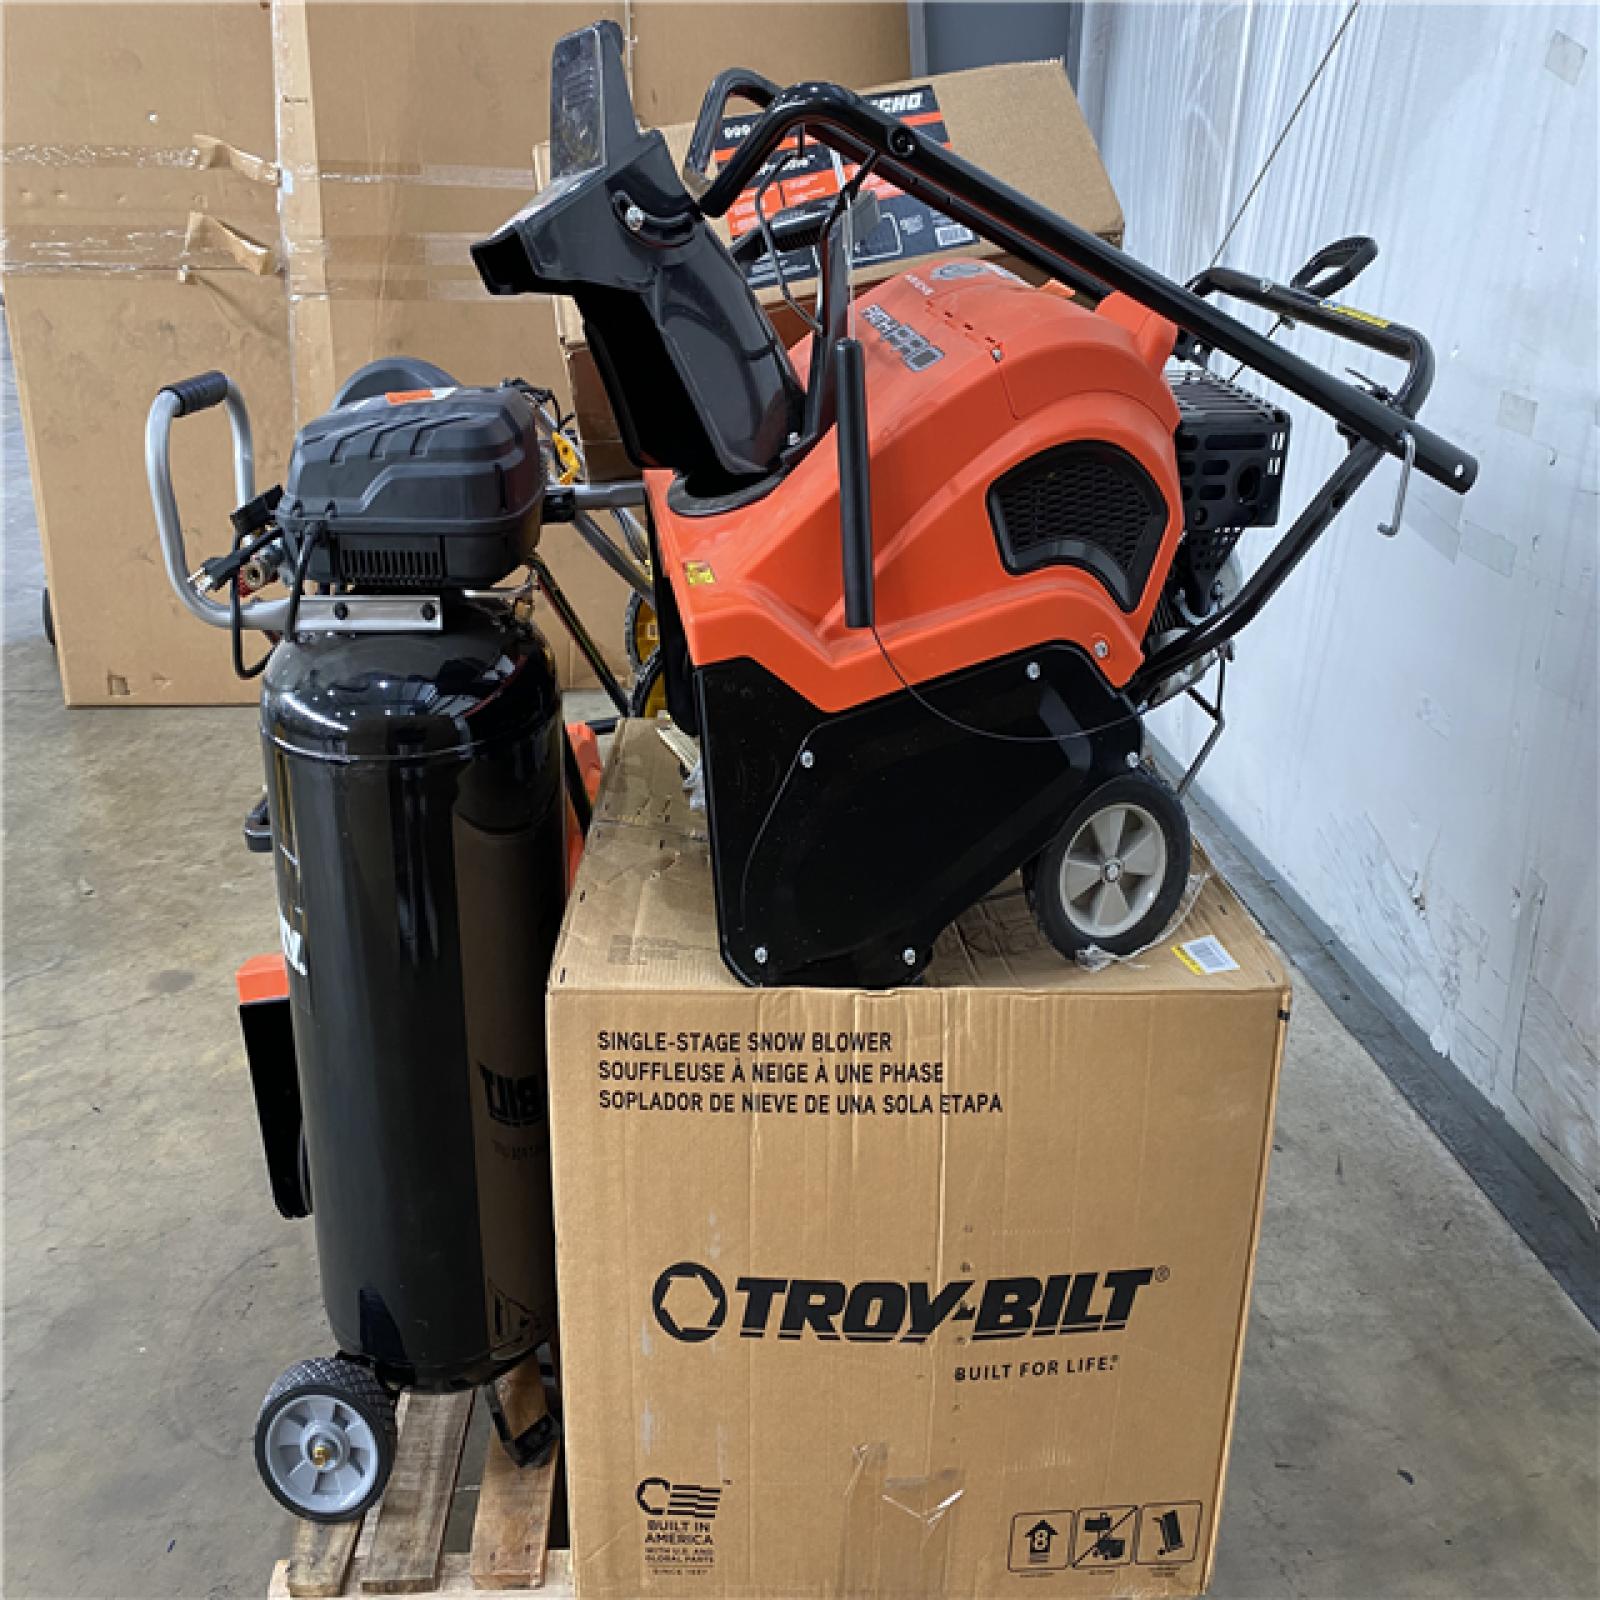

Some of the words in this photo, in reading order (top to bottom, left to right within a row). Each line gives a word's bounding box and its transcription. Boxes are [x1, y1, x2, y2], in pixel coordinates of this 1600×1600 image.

[598, 1031, 741, 1053] SINGLE-STAGE
[747, 1031, 805, 1053] SNOW
[812, 1031, 892, 1053] BLOWER
[598, 1061, 724, 1083] SOUFFLEUSE
[731, 1057, 746, 1083] À
[751, 1062, 808, 1083] NEIGE
[814, 1057, 829, 1083] À
[835, 1062, 873, 1084] UNE
[879, 1062, 944, 1084] PHASE
[599, 1089, 703, 1112] SOPLADOR
[709, 1092, 734, 1112] DE
[741, 1092, 798, 1113] NIEVE
[804, 1093, 830, 1114] DE
[836, 1094, 876, 1114] UNA
[882, 1094, 933, 1114] SOLA
[939, 1093, 1003, 1114] ETAPA
[954, 1363, 1012, 1382] BUILT
[1019, 1360, 1059, 1378] FOR
[647, 1519, 690, 1531] BUILT
[694, 1521, 711, 1532] IN
[644, 1532, 714, 1545] AMERICA
